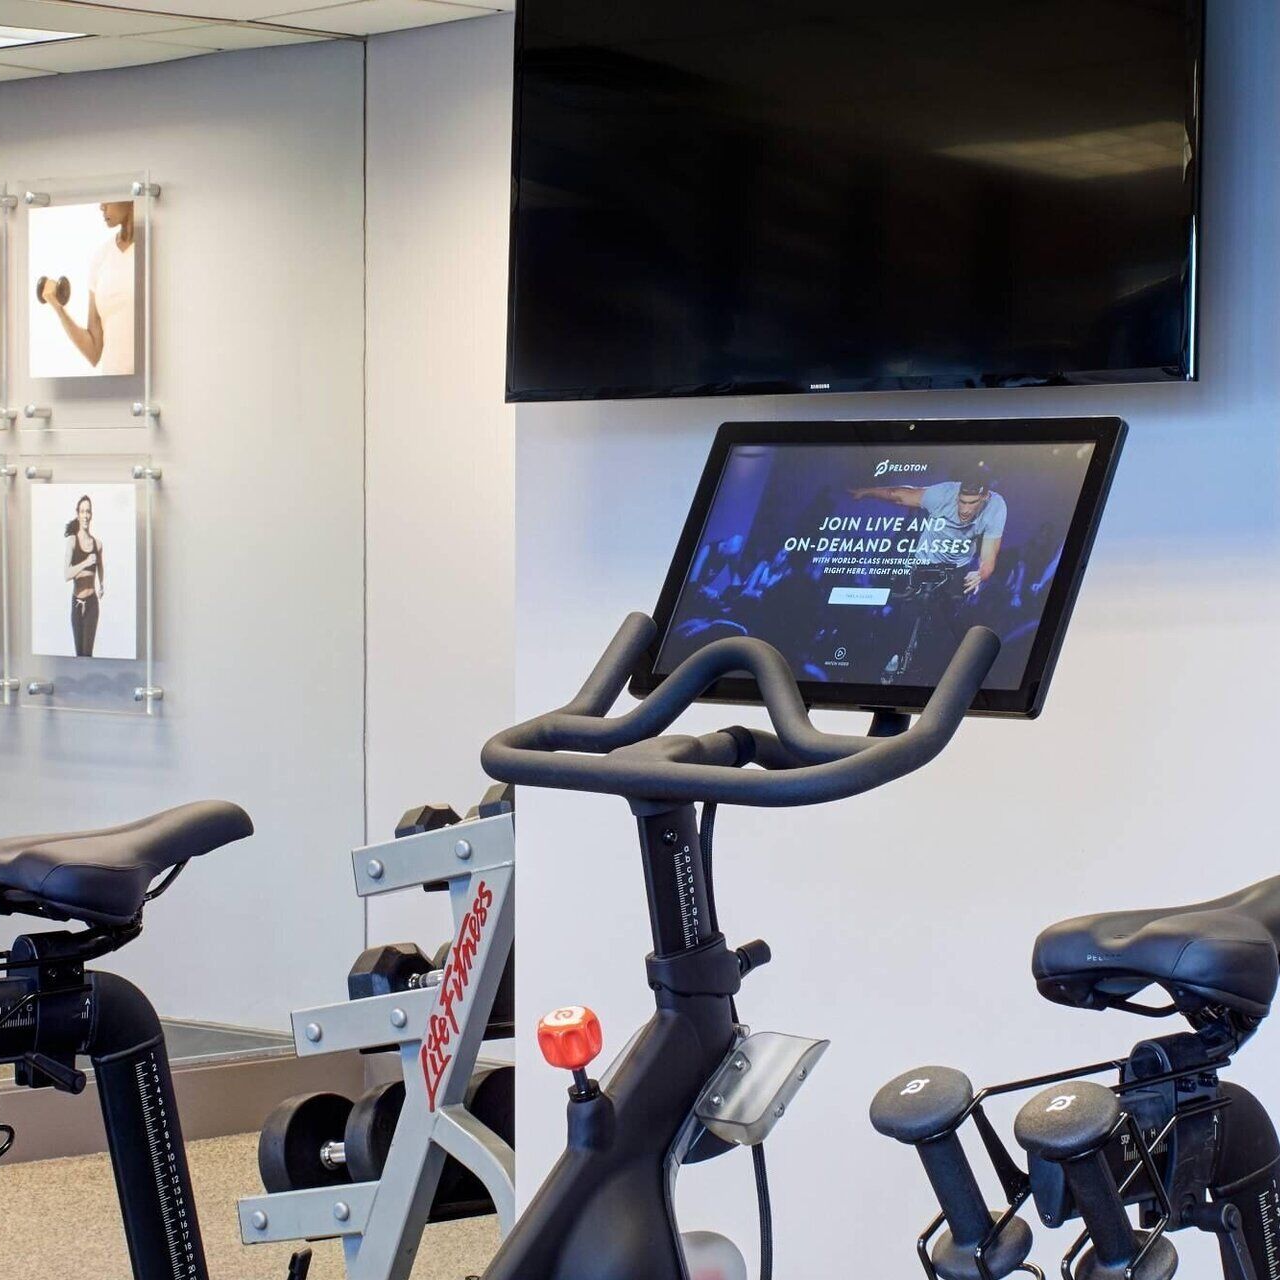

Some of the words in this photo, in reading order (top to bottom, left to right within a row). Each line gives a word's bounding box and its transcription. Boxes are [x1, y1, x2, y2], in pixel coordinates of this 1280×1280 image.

[888, 463, 928, 473] PELOTON
[819, 516, 862, 531] JOIN
[865, 517, 905, 532] LIVE
[907, 517, 946, 532] AND
[784, 537, 892, 553] ON-DEMAND
[896, 538, 972, 554] CLASSES
[812, 557, 830, 565] WITH
[831, 557, 881, 566] WORLD-CLASS
[882, 558, 931, 567] INSTRUCTORS
[823, 567, 845, 575] RIGHT
[846, 567, 867, 576] HERE,
[868, 568, 891, 576] RIGHT
[892, 568, 912, 576] NOW.
[420, 1014, 452, 1112] Life
[439, 880, 493, 1034] Fitness
